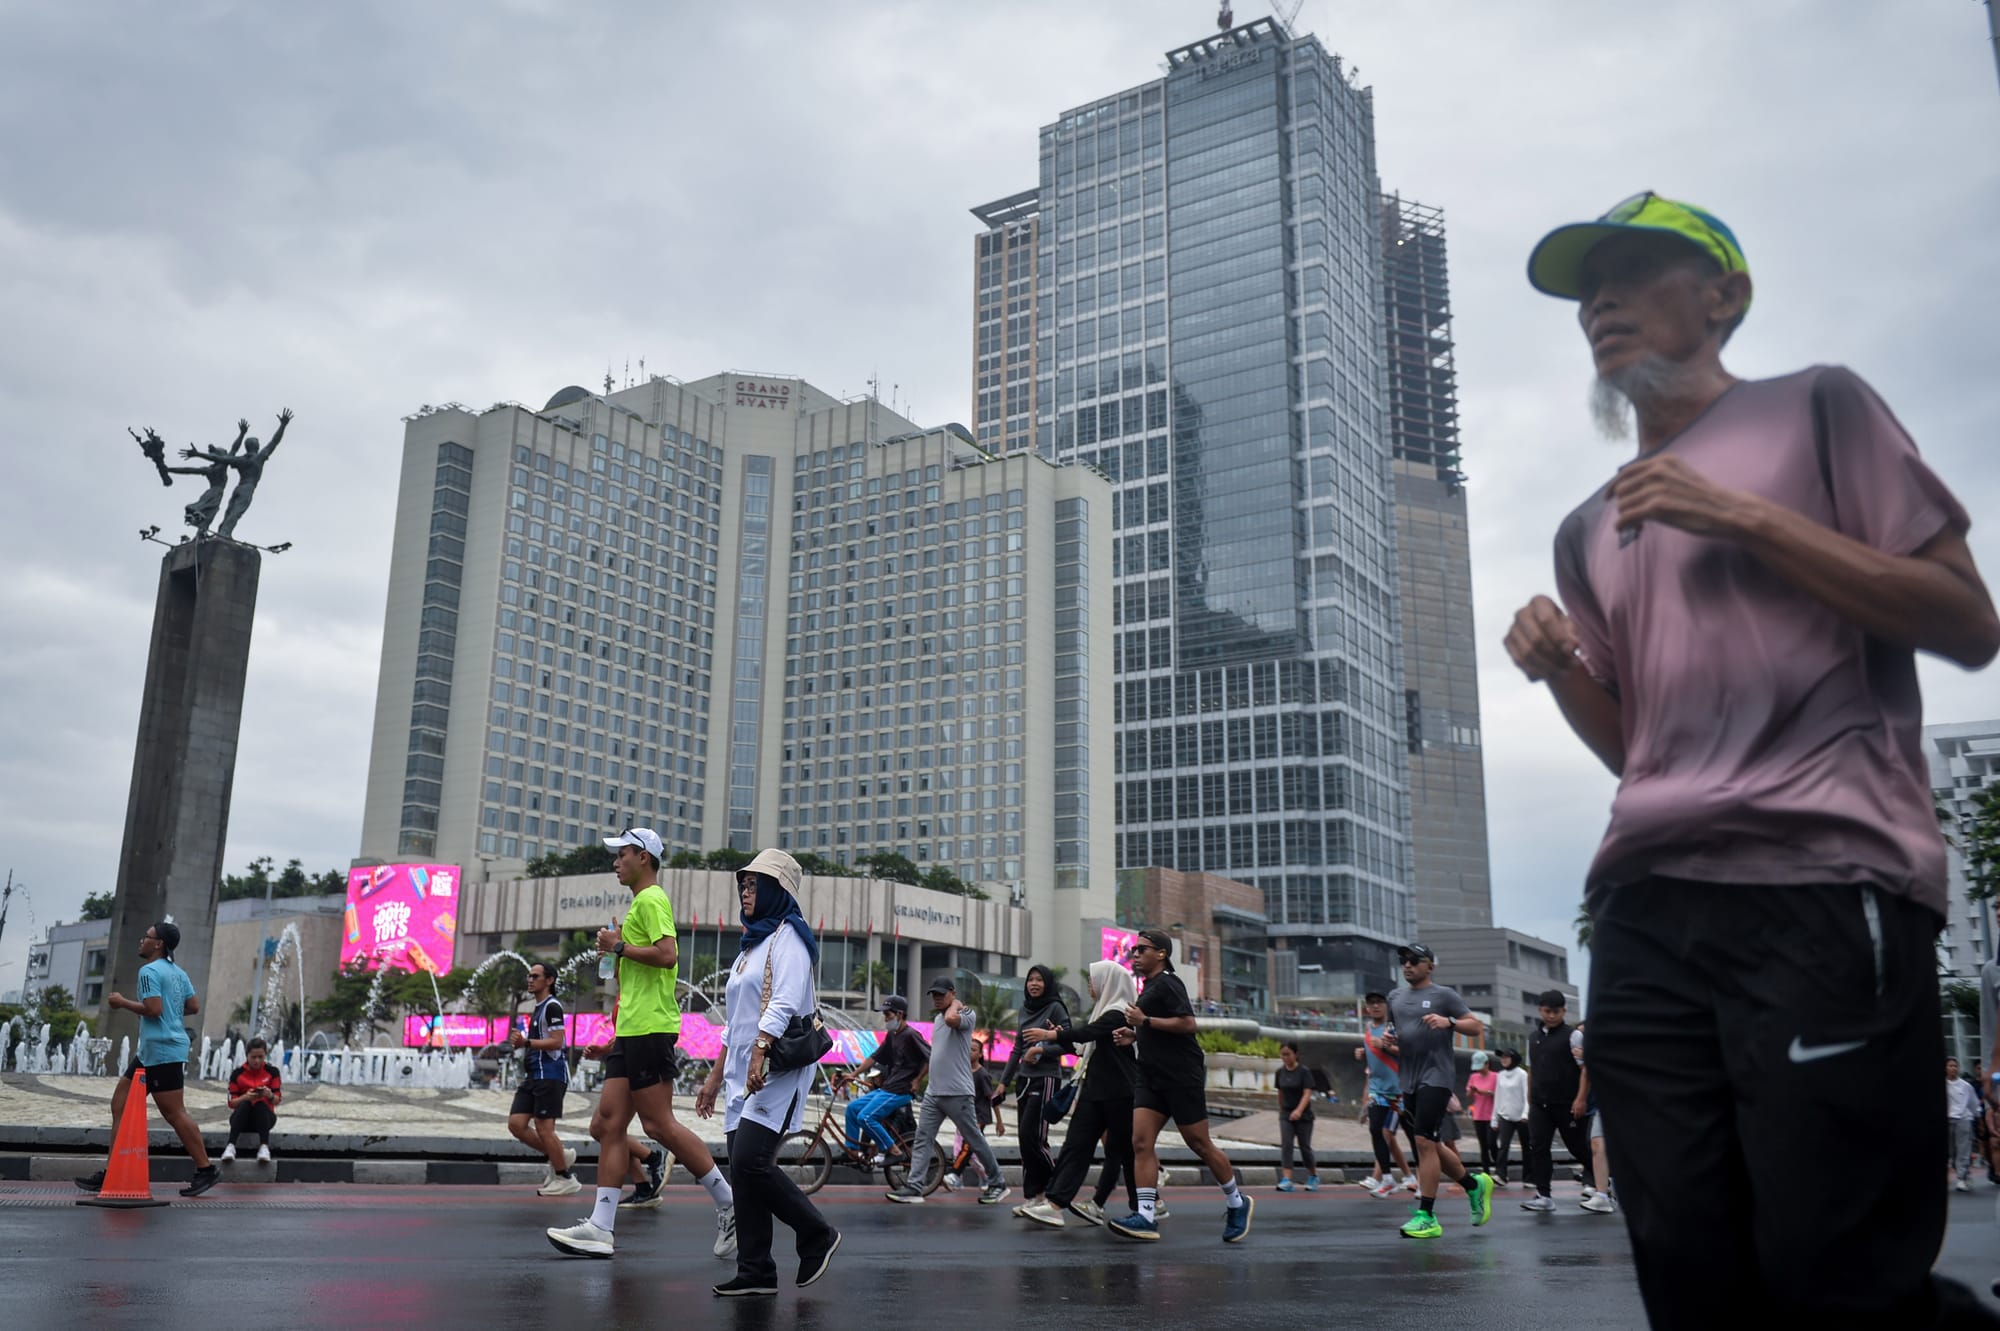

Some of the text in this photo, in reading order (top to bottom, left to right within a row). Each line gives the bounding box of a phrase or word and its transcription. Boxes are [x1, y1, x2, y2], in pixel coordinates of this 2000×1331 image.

[736, 381, 790, 395] GRAND
[736, 396, 787, 410] HYATT
[608, 893, 633, 906] HYA
